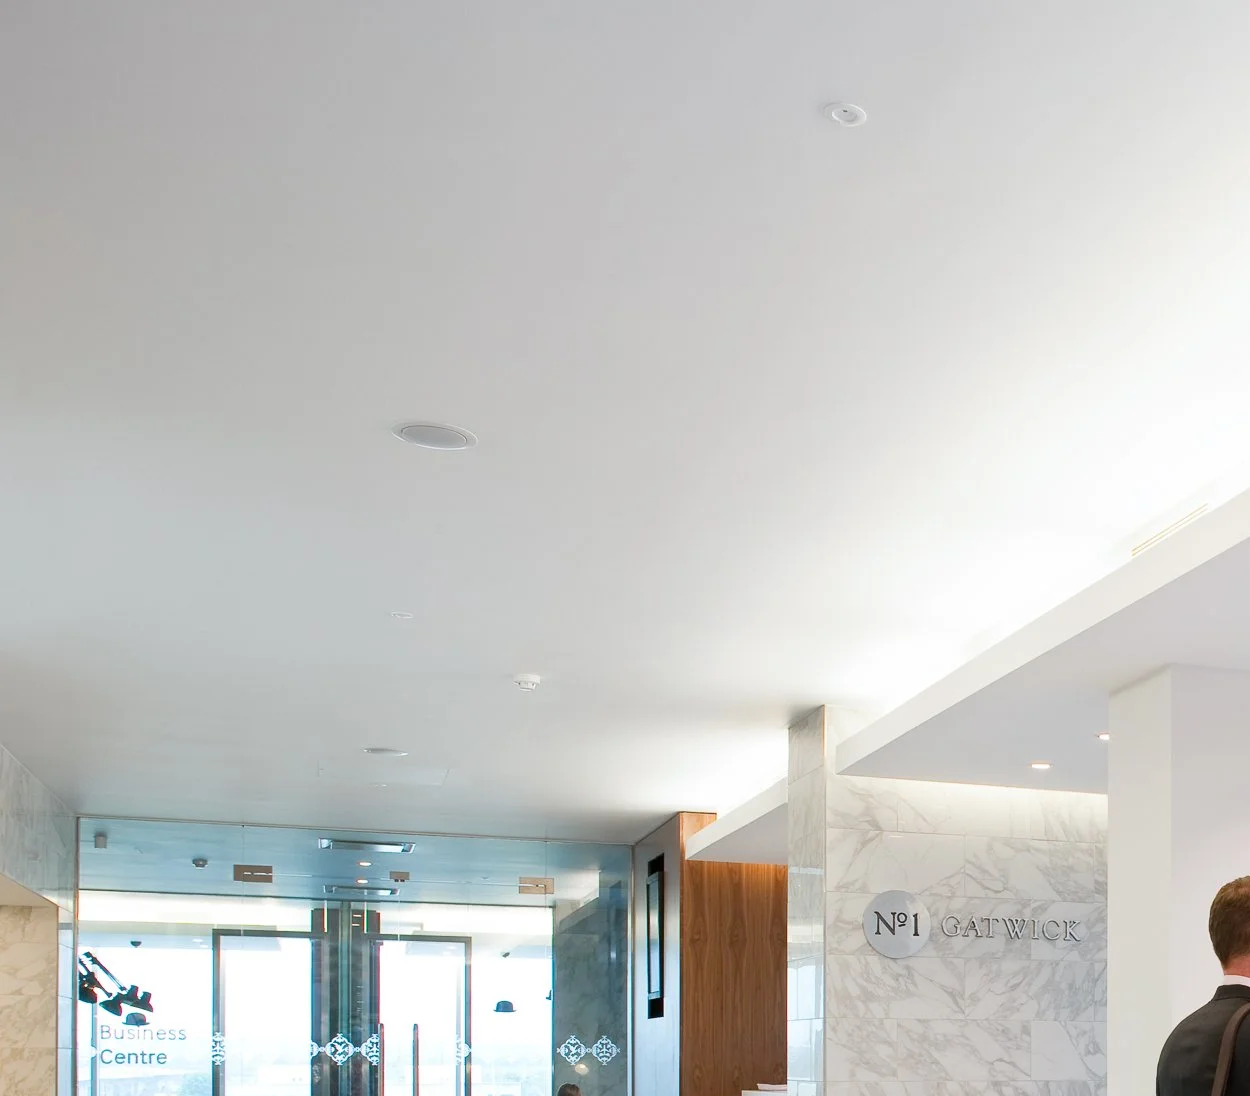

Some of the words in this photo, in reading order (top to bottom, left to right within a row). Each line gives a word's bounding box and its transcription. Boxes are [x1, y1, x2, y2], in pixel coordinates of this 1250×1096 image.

[940, 915, 1081, 942] GATWICK
[100, 1024, 187, 1041] Business
[100, 1048, 168, 1065] Centre
